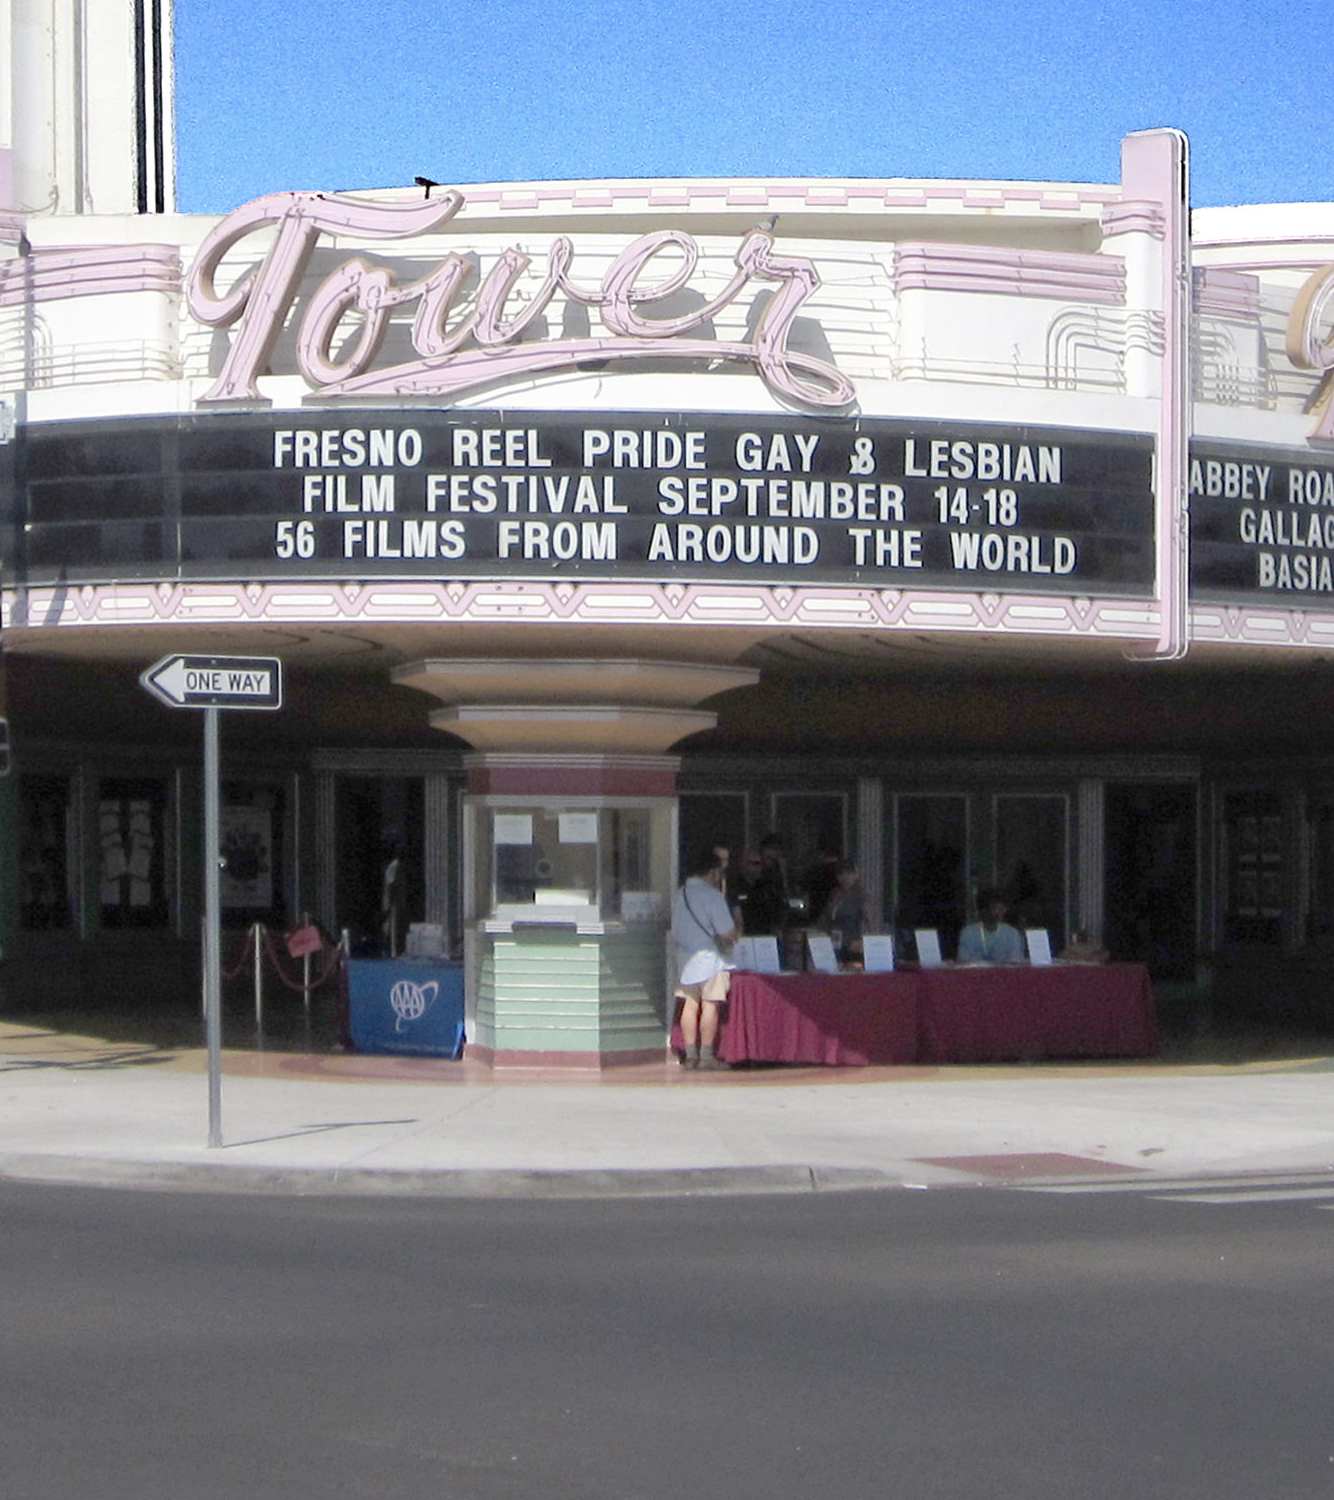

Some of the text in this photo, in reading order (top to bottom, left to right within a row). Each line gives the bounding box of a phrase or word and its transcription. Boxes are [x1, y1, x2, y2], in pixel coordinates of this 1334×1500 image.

[188, 190, 857, 407] Tower
[273, 429, 1062, 484] FRESNO REEL PRIDE GAY & LESBIAN
[1189, 459, 1271, 501] ABBEY
[303, 475, 1019, 527] FILM FESTIVAL SEPTEMBER 14-18
[275, 520, 1077, 575] 56 FILMS FROM AROUND THE WORLD
[1259, 552, 1334, 592] BASIA
[186, 671, 265, 693] ONE WAY
